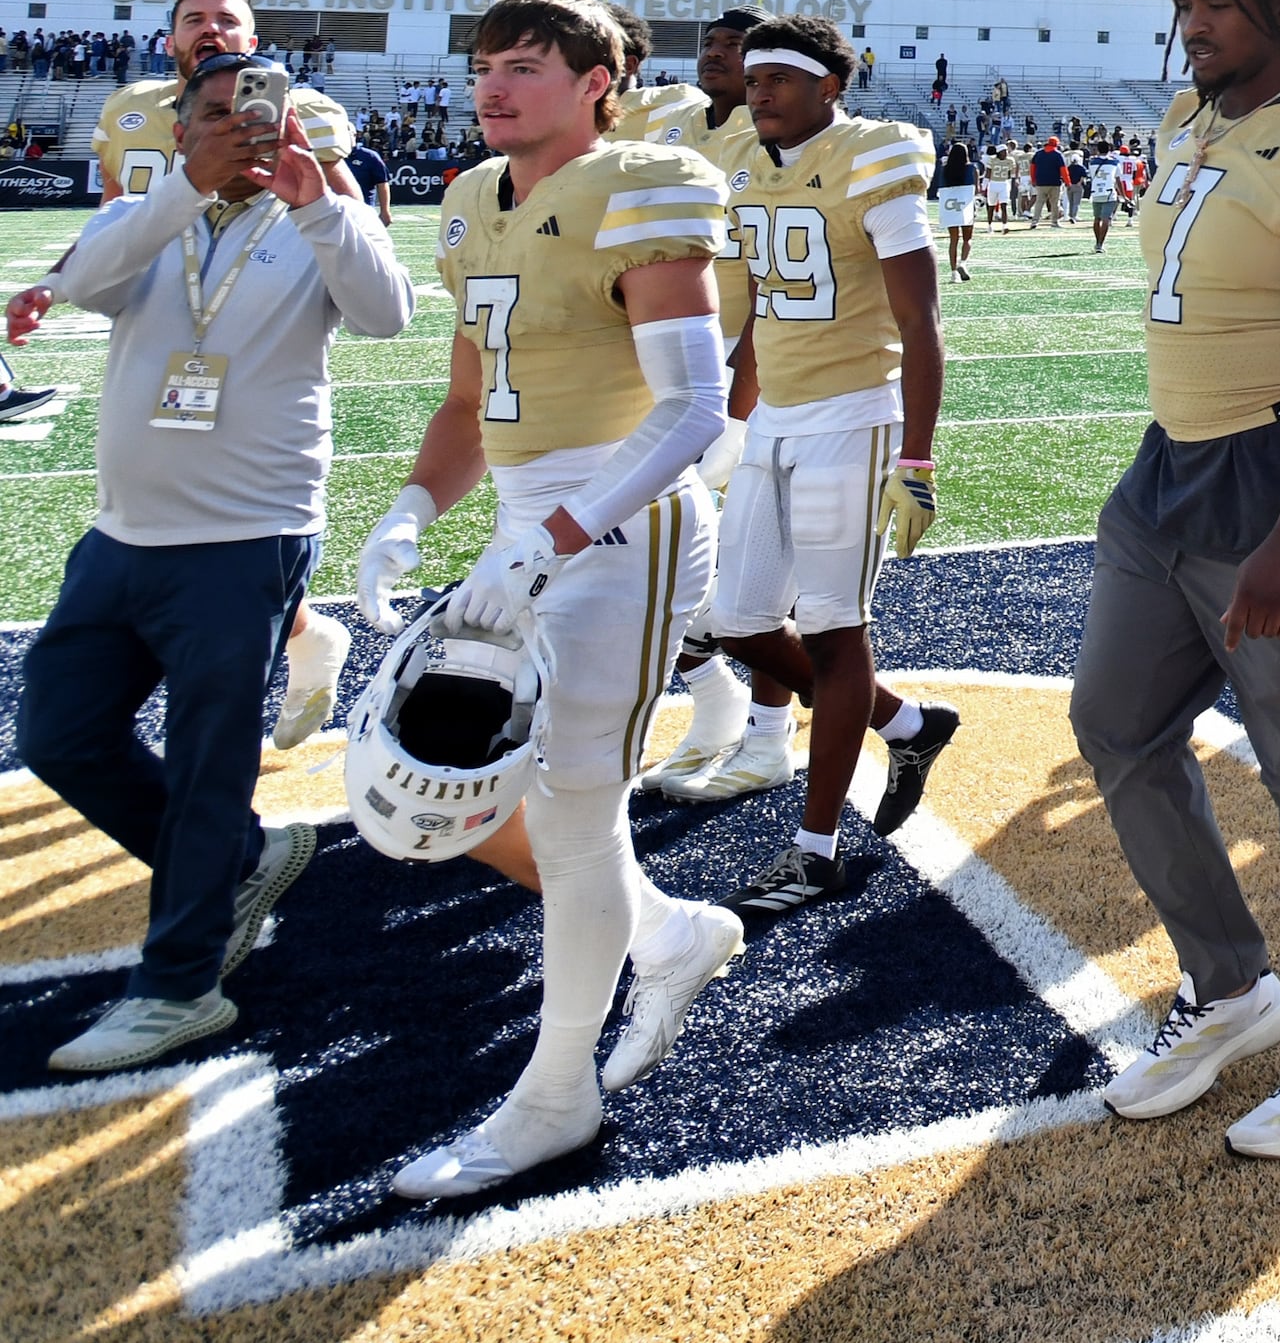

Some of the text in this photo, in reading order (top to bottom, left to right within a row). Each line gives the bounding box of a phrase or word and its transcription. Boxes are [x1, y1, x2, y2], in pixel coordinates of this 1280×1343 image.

[994, 165, 1013, 178] 22
[1157, 162, 1227, 324] 7
[184, 360, 209, 374] GT
[464, 275, 520, 422] 7
[386, 762, 499, 800] JACKETS
